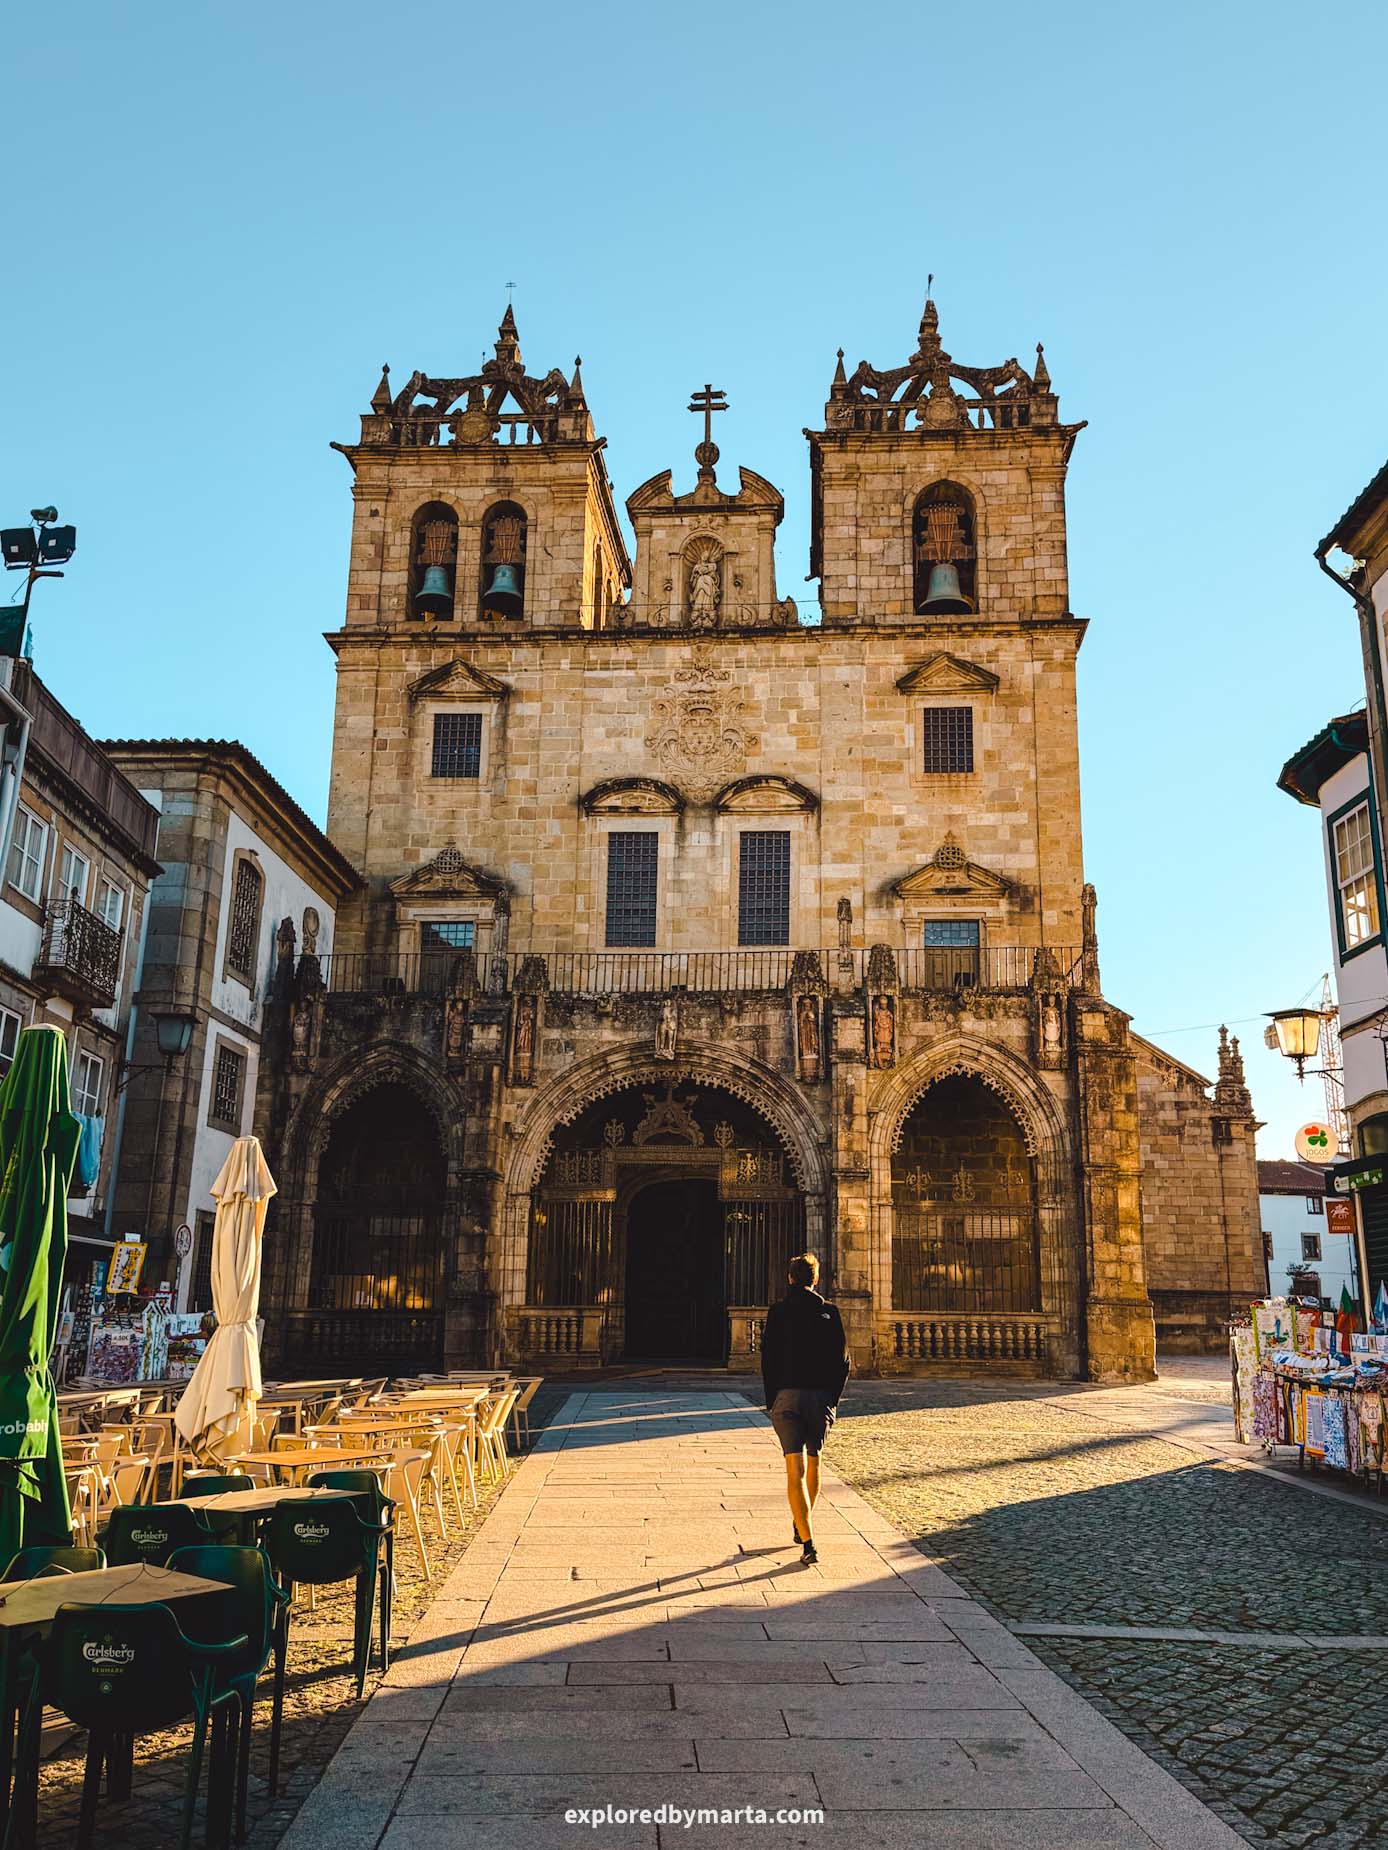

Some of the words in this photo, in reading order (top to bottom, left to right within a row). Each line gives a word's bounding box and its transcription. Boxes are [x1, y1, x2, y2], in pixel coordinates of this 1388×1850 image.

[131, 1529, 168, 1544] Carlsberg
[294, 1523, 330, 1538] Carlsberg
[83, 1642, 135, 1665] Carlsberg
